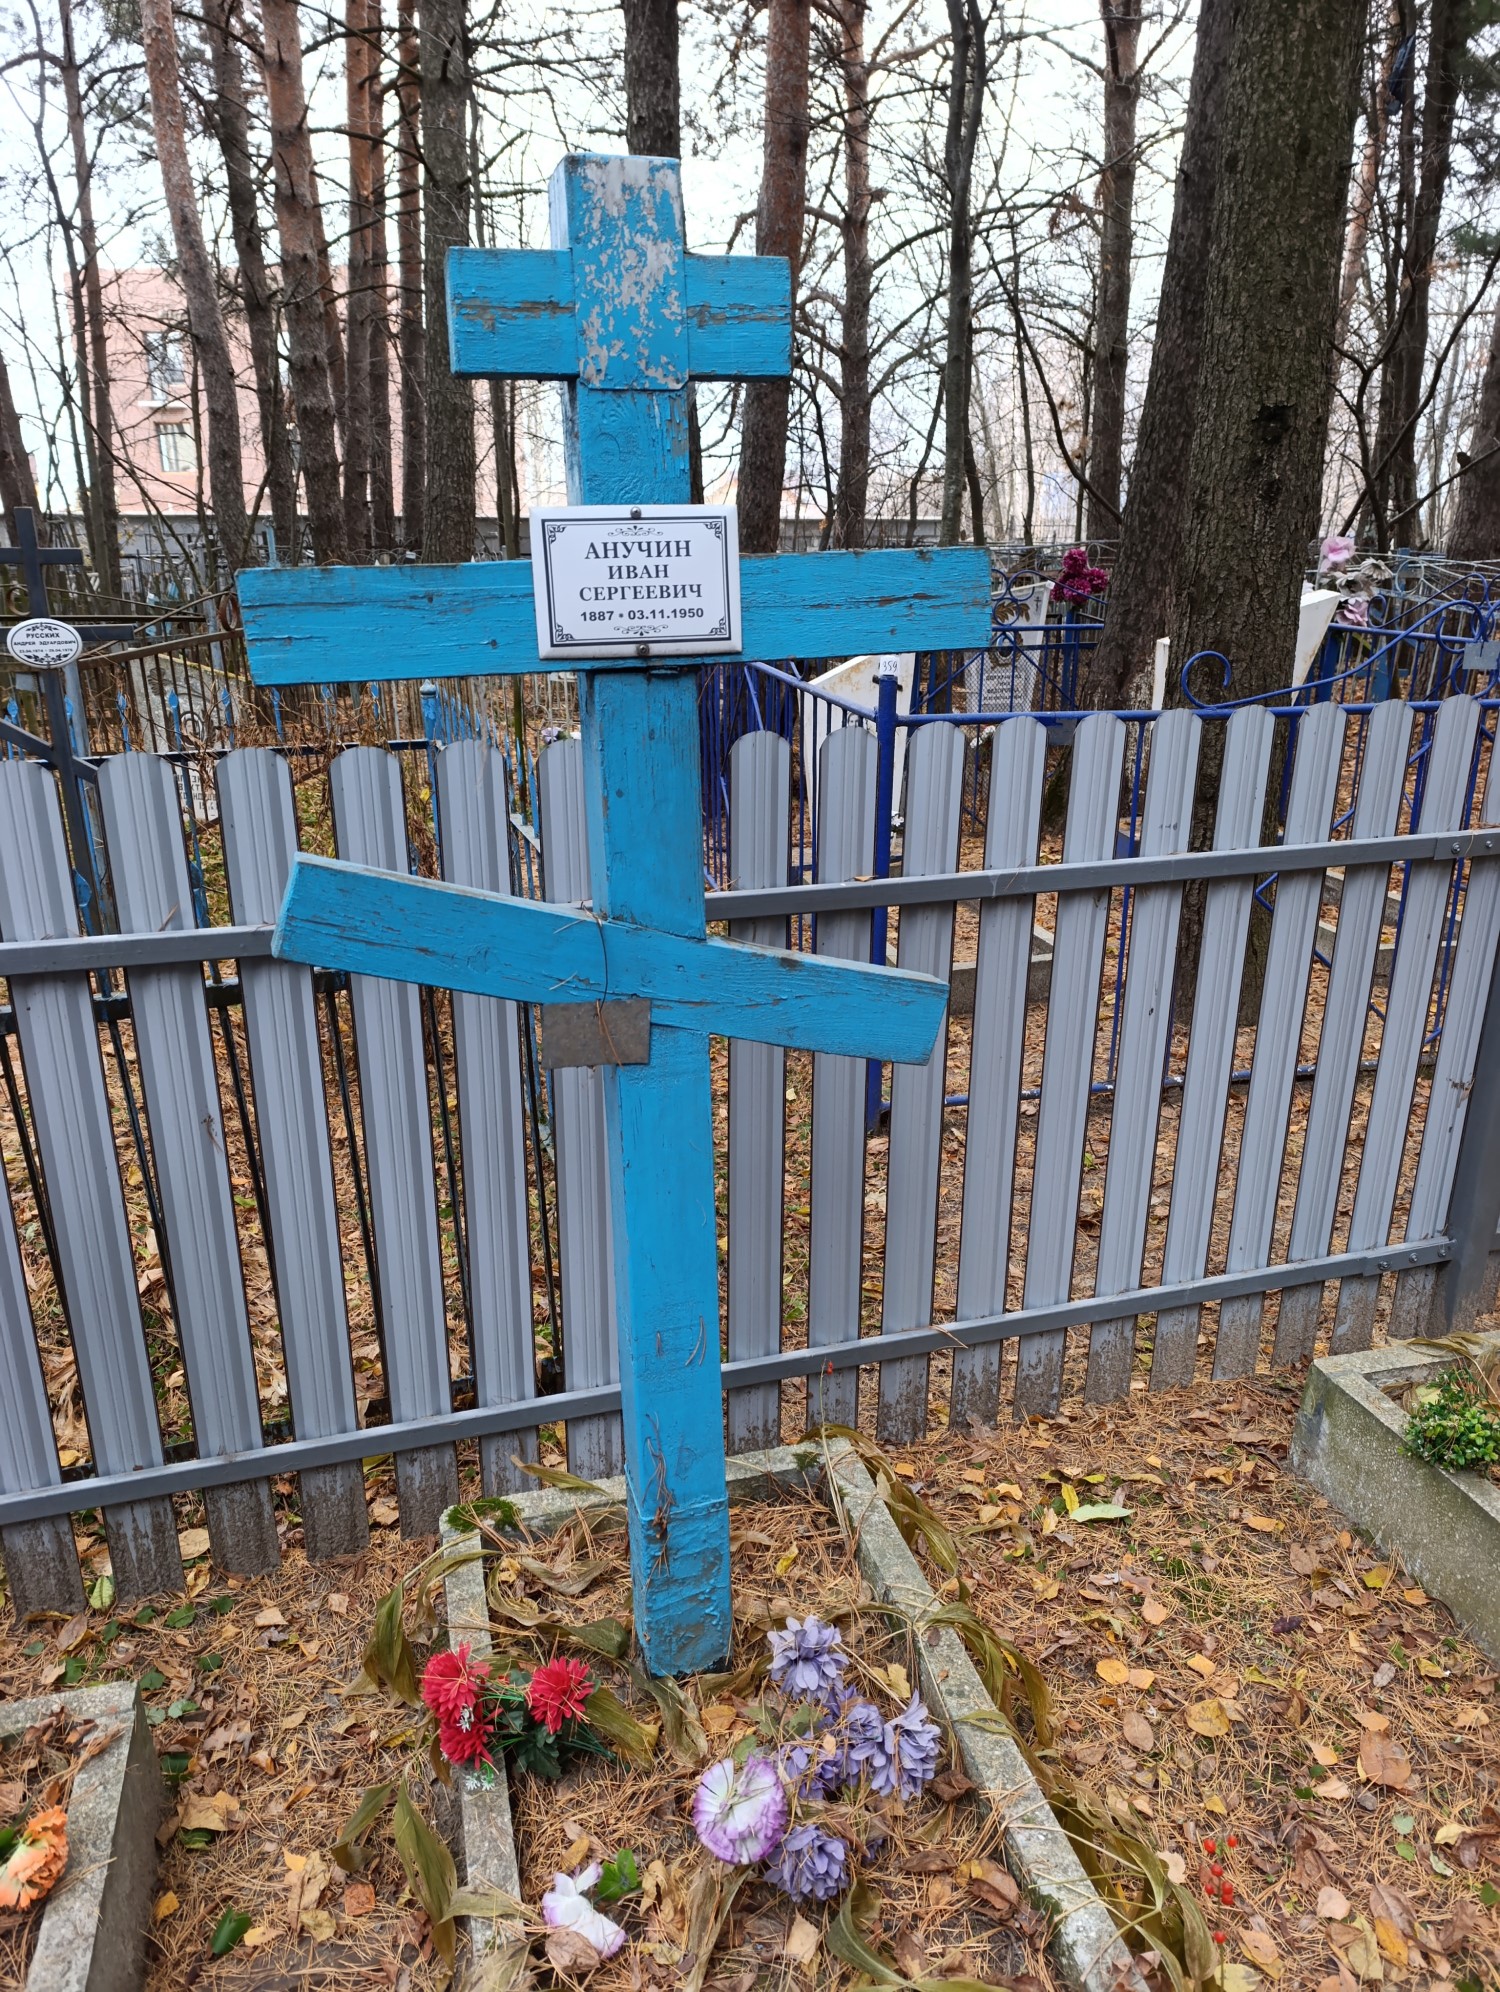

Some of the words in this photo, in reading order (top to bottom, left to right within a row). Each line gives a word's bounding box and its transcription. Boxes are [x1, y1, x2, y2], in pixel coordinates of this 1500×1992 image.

[584, 540, 692, 559] АНУЧИН
[607, 564, 669, 580] ИВАН
[579, 584, 703, 601] СЕРГЕЕВИЧ
[580, 610, 615, 622] 1887
[627, 607, 704, 620] 03.11.1950
